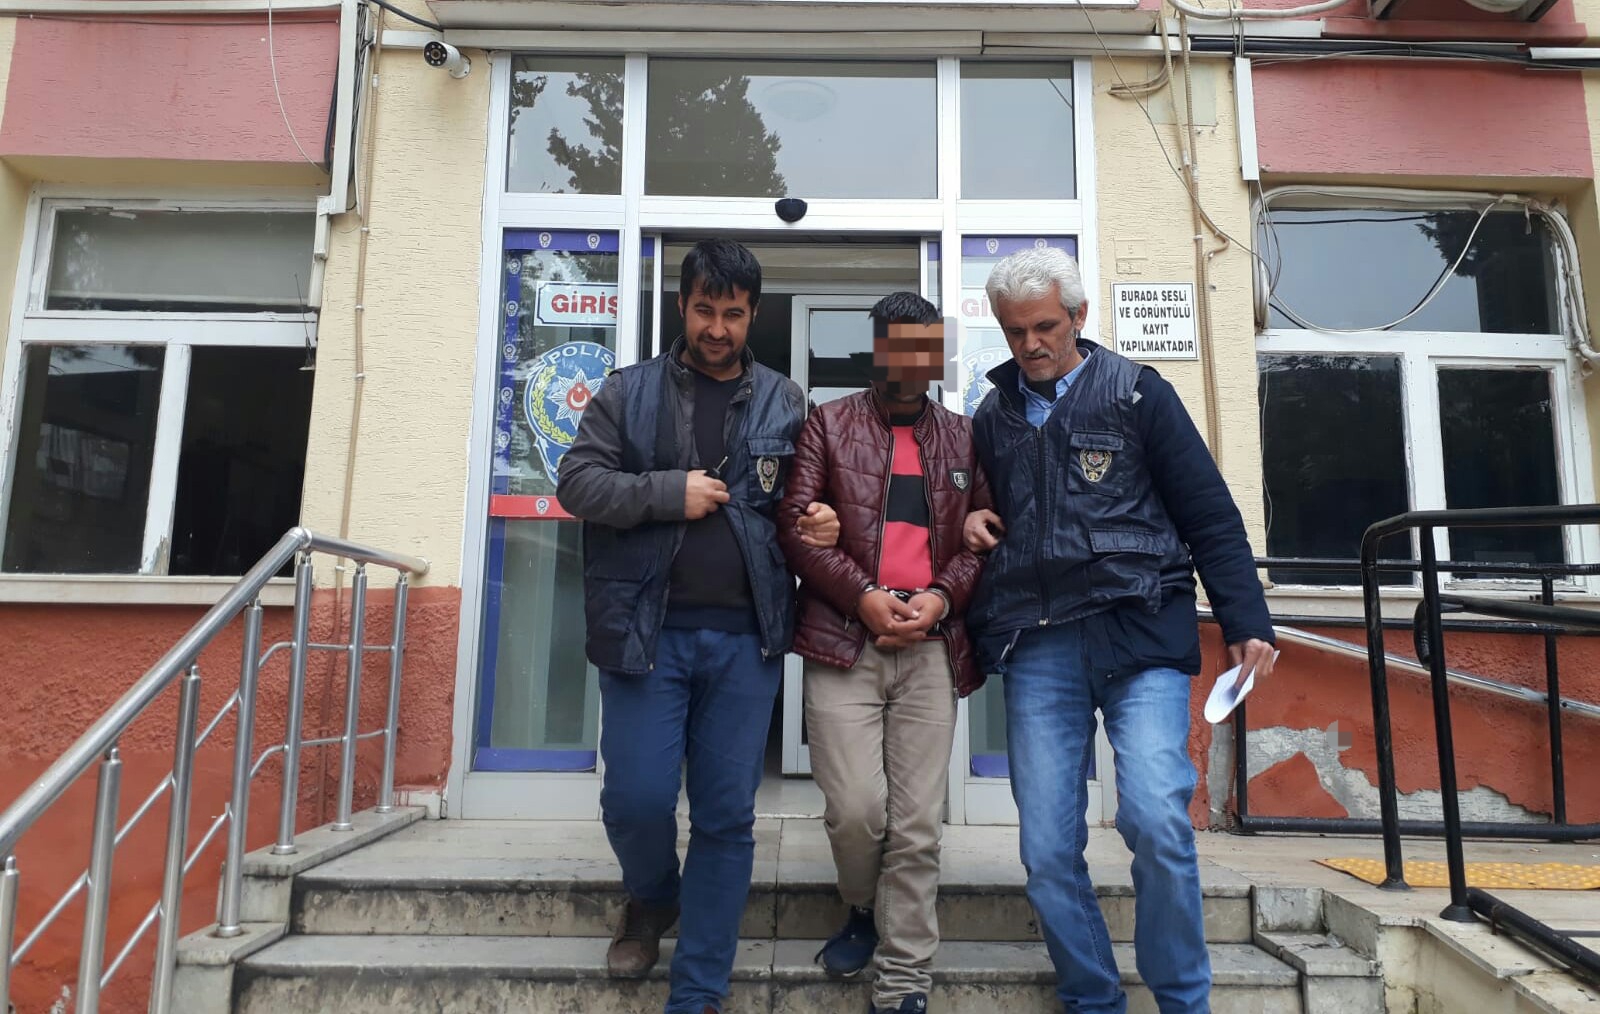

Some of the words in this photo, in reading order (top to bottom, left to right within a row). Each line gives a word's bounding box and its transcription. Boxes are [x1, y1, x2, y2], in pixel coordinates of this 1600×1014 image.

[1121, 290, 1159, 302] BURADA
[1119, 306, 1131, 318] VE
[1133, 303, 1191, 319] GÖRÜNTÜLÜ
[1142, 323, 1169, 335] KAYIT
[1120, 340, 1194, 352] YAPILMAKTADIR
